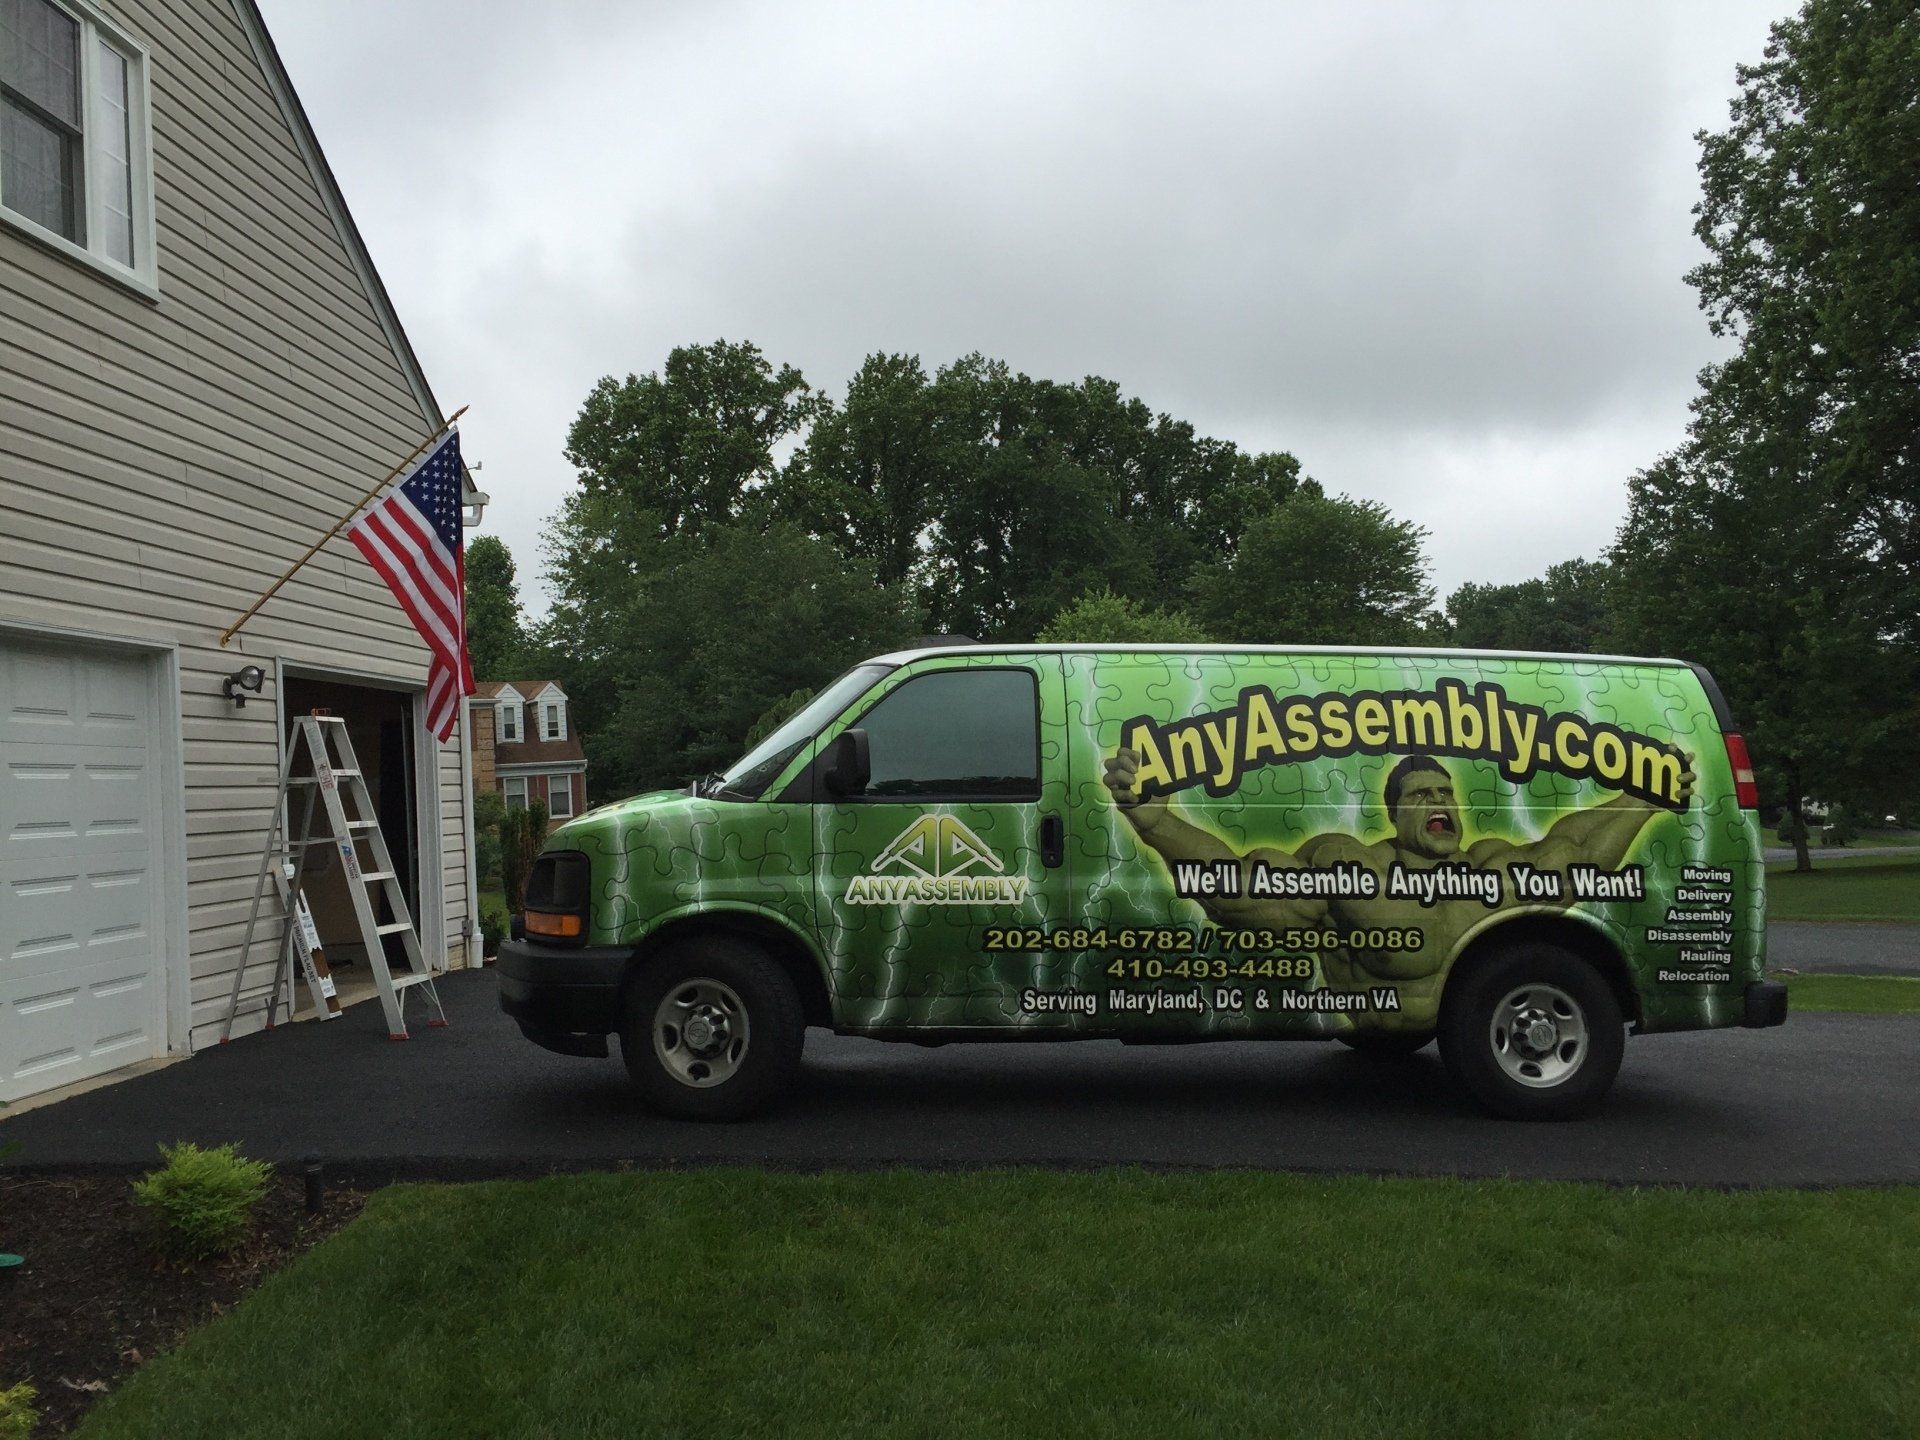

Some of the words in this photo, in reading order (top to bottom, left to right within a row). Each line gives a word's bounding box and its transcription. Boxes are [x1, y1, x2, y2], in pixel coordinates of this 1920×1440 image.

[1129, 686, 1682, 804] AnyAssembly.com
[1177, 864, 1238, 894] We'll
[1253, 865, 1375, 895] Assemble
[1391, 866, 1500, 903] Anything
[1512, 867, 1560, 897] You
[1572, 868, 1642, 898] Want!
[1684, 869, 1731, 883] Moving
[848, 878, 1027, 902] ANYASSEMBLY
[1678, 889, 1732, 903] Delivery
[1667, 909, 1732, 924] Assembly
[986, 930, 1193, 949] 202-684-6782
[1220, 930, 1422, 949] 703-596-0086
[1648, 930, 1732, 943] Disassembly
[1681, 950, 1731, 964] Hauling
[1107, 959, 1312, 978] 410-493-4488
[1659, 970, 1730, 981] Relocation
[1023, 989, 1097, 1015] Serving
[1109, 989, 1204, 1014] Maryland,
[1216, 990, 1243, 1009] DC
[1255, 989, 1270, 1009] &
[1282, 989, 1367, 1010] Northern
[1372, 989, 1399, 1009] VA
